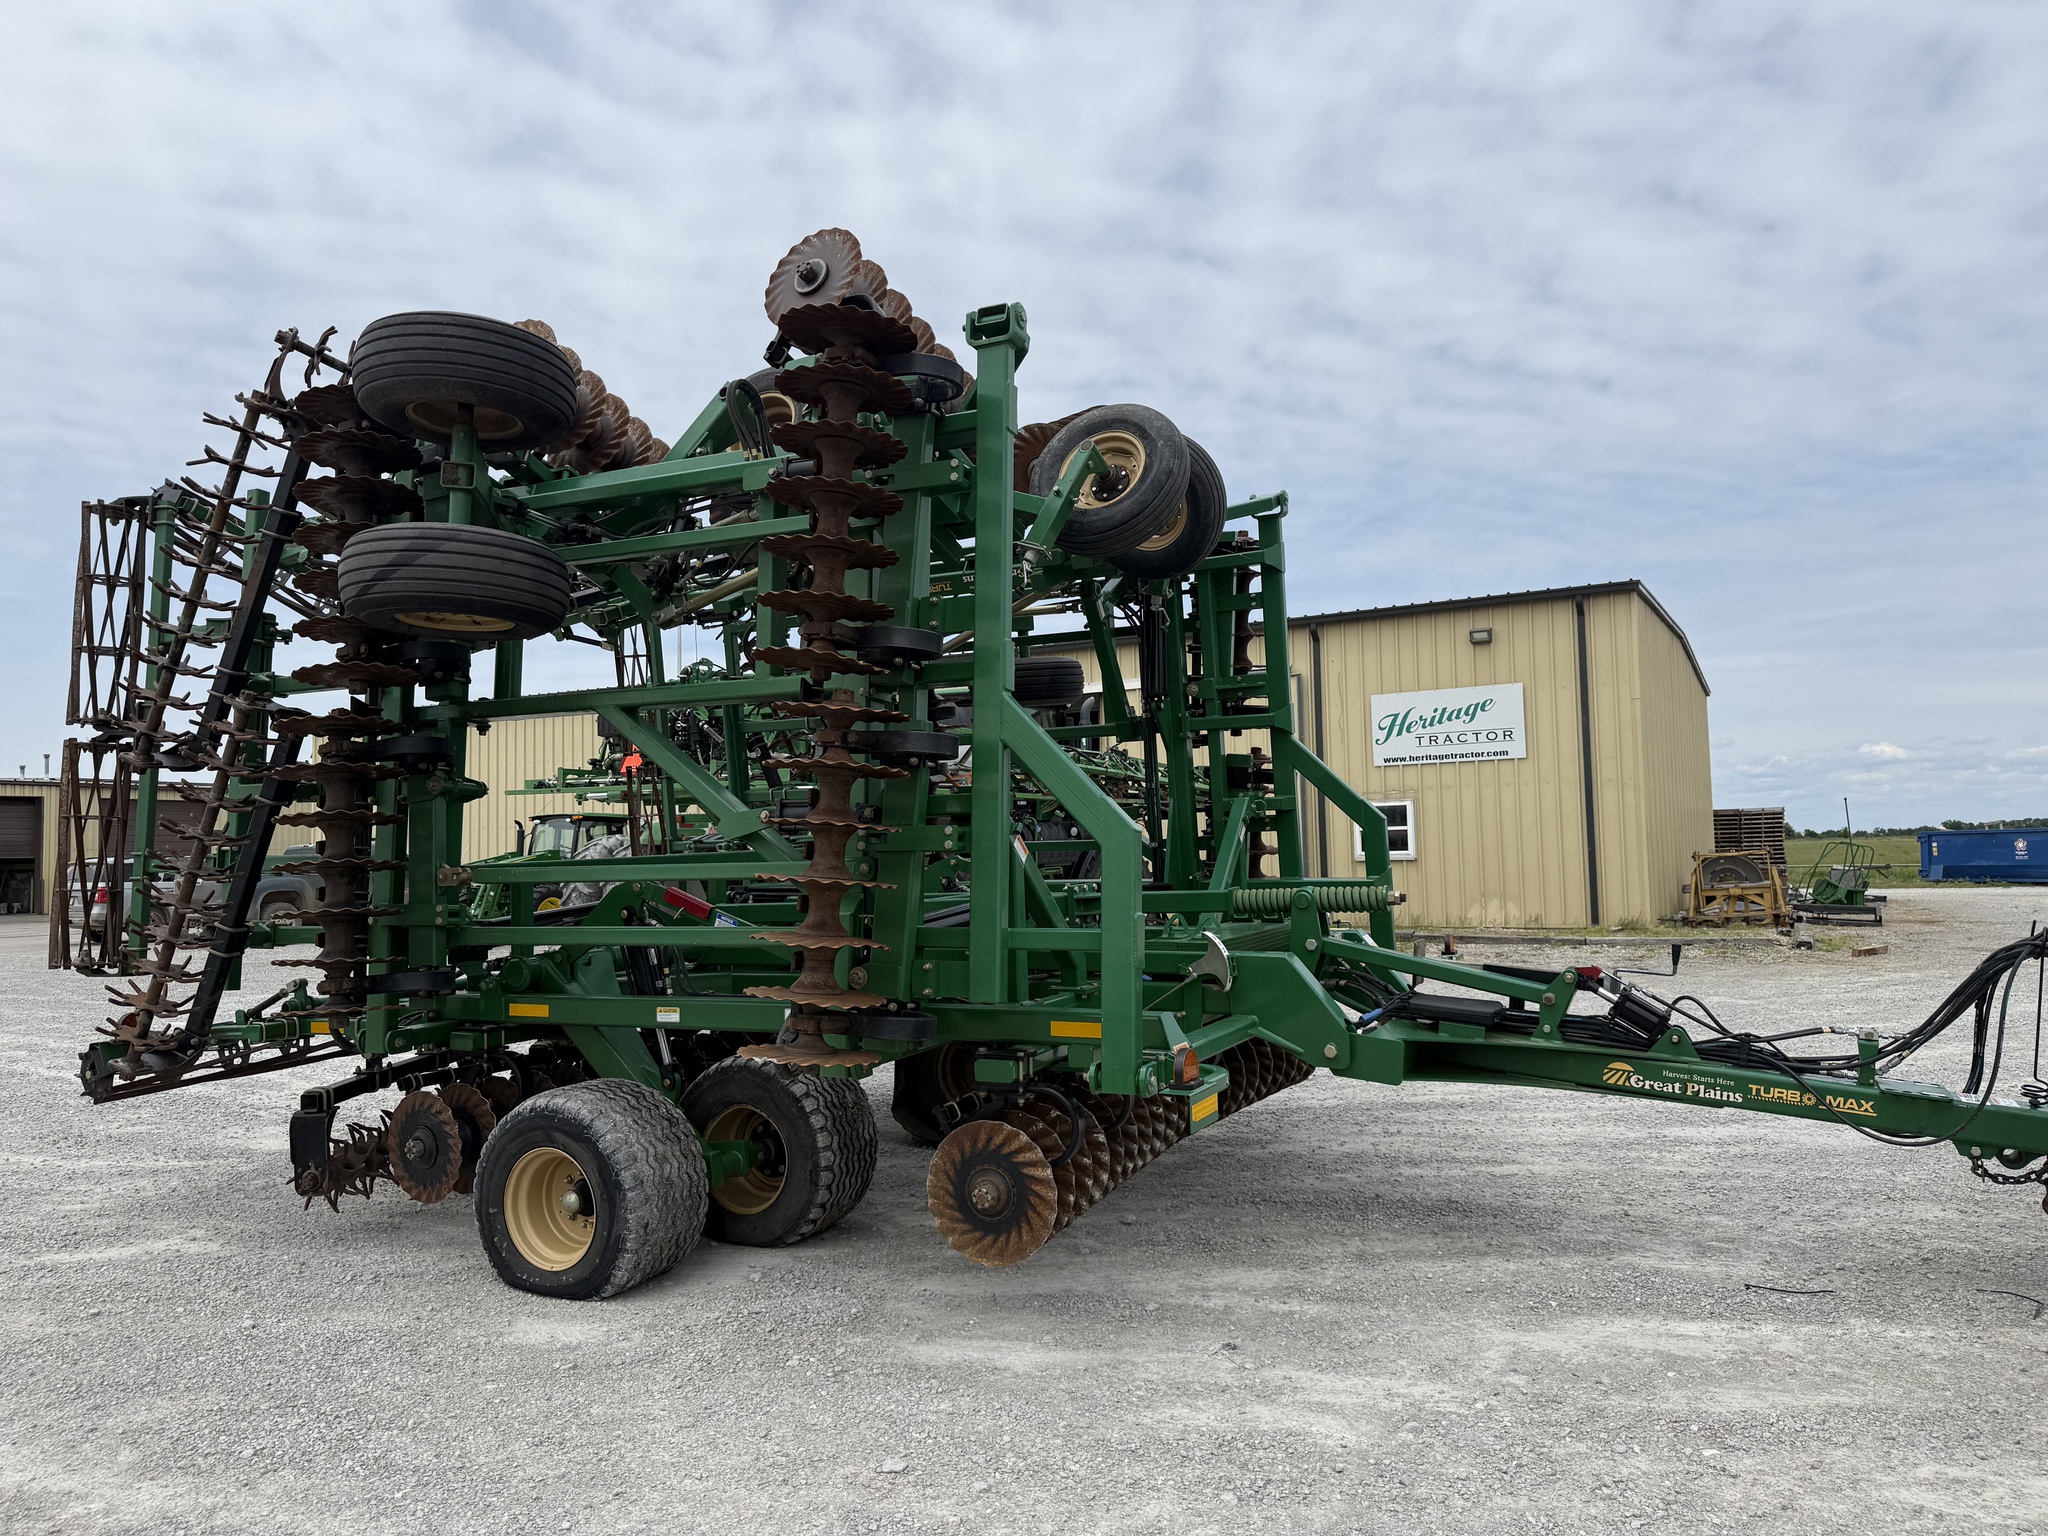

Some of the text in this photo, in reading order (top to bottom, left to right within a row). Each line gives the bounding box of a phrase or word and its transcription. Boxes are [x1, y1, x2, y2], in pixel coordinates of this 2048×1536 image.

[1375, 698, 1496, 746] Heritage
[1415, 730, 1514, 746] TRACTOR
[1383, 750, 1509, 764] www.heritagetractor.com
[1662, 1069, 1735, 1086] Harvest Starts Here
[1629, 1074, 1743, 1103] Great Plains
[1825, 1095, 1875, 1113] MAX
